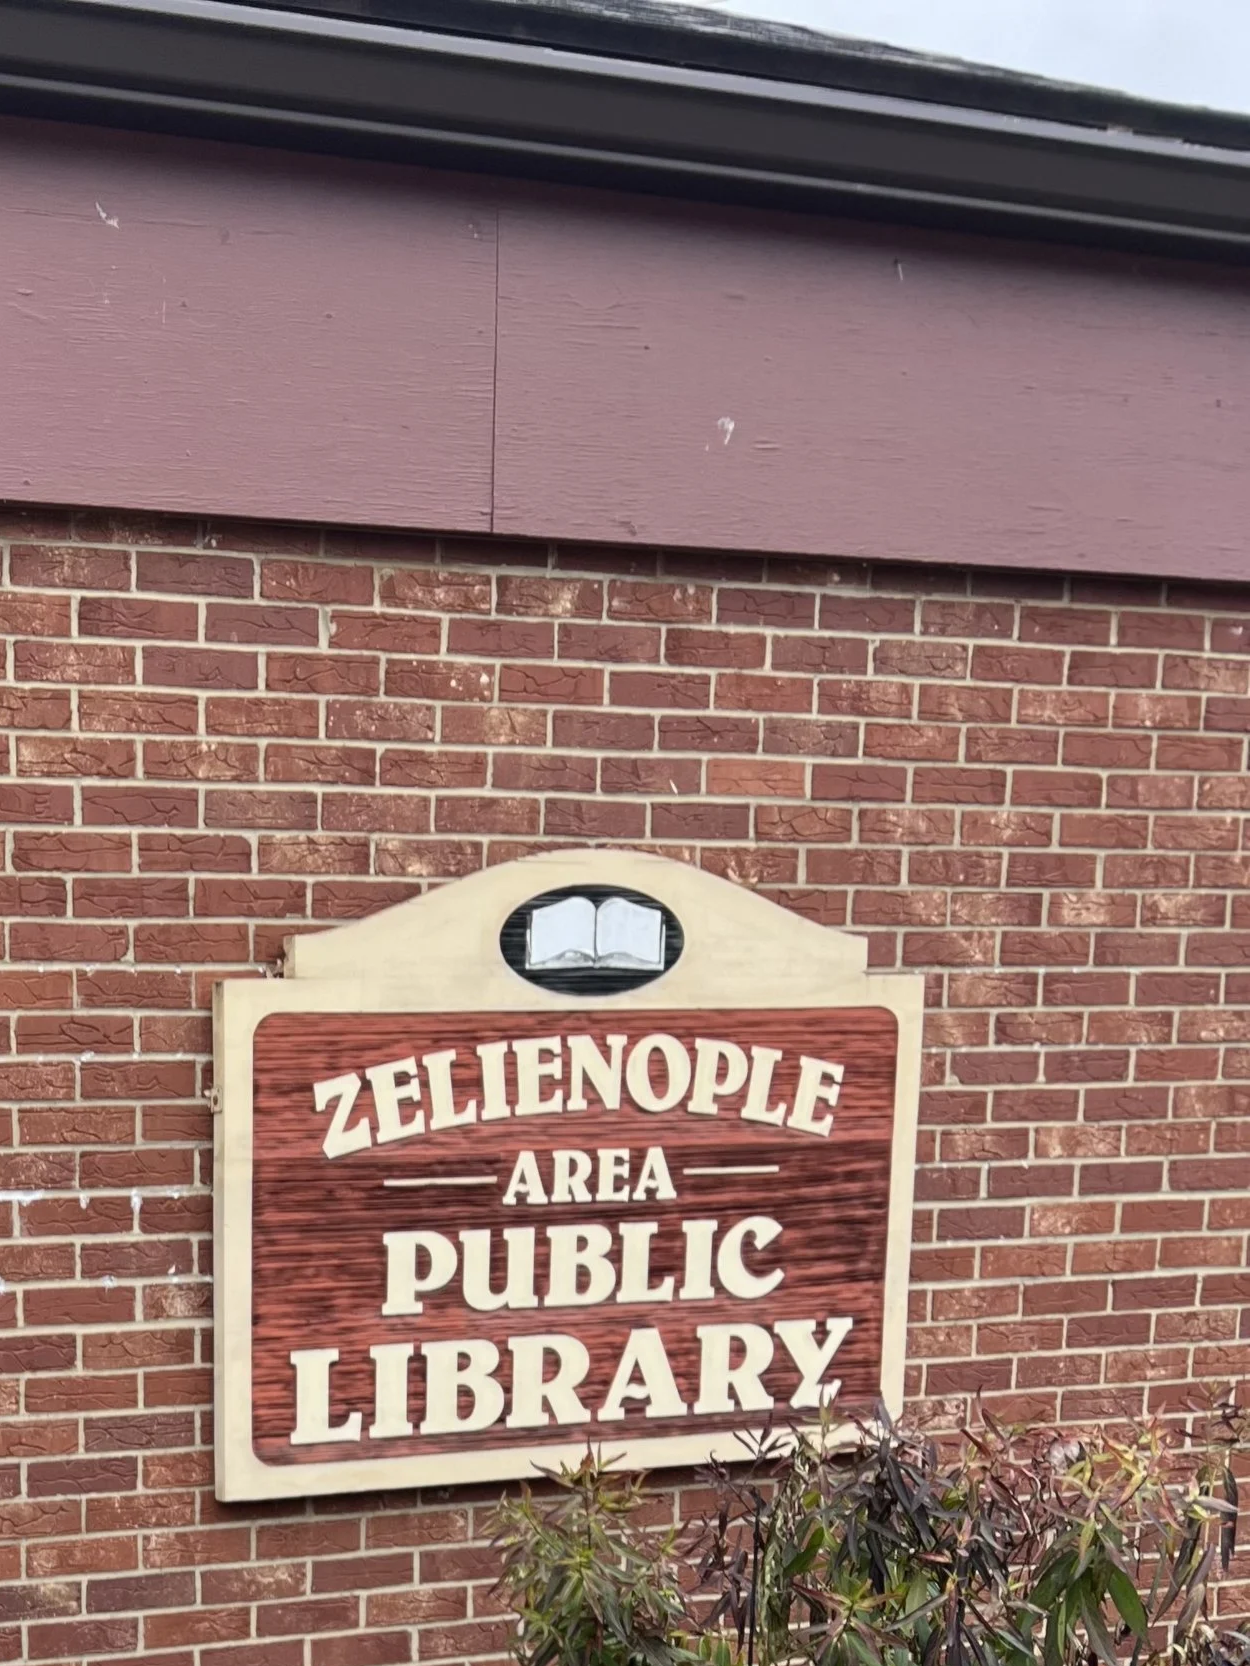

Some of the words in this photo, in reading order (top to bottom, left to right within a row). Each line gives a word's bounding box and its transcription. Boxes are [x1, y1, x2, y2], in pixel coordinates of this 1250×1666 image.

[314, 1034, 844, 1159] ZELIENOPLE
[503, 1147, 677, 1205] AREA
[382, 1217, 785, 1316] PUBLIC
[291, 1317, 852, 1445] LIBRARY
